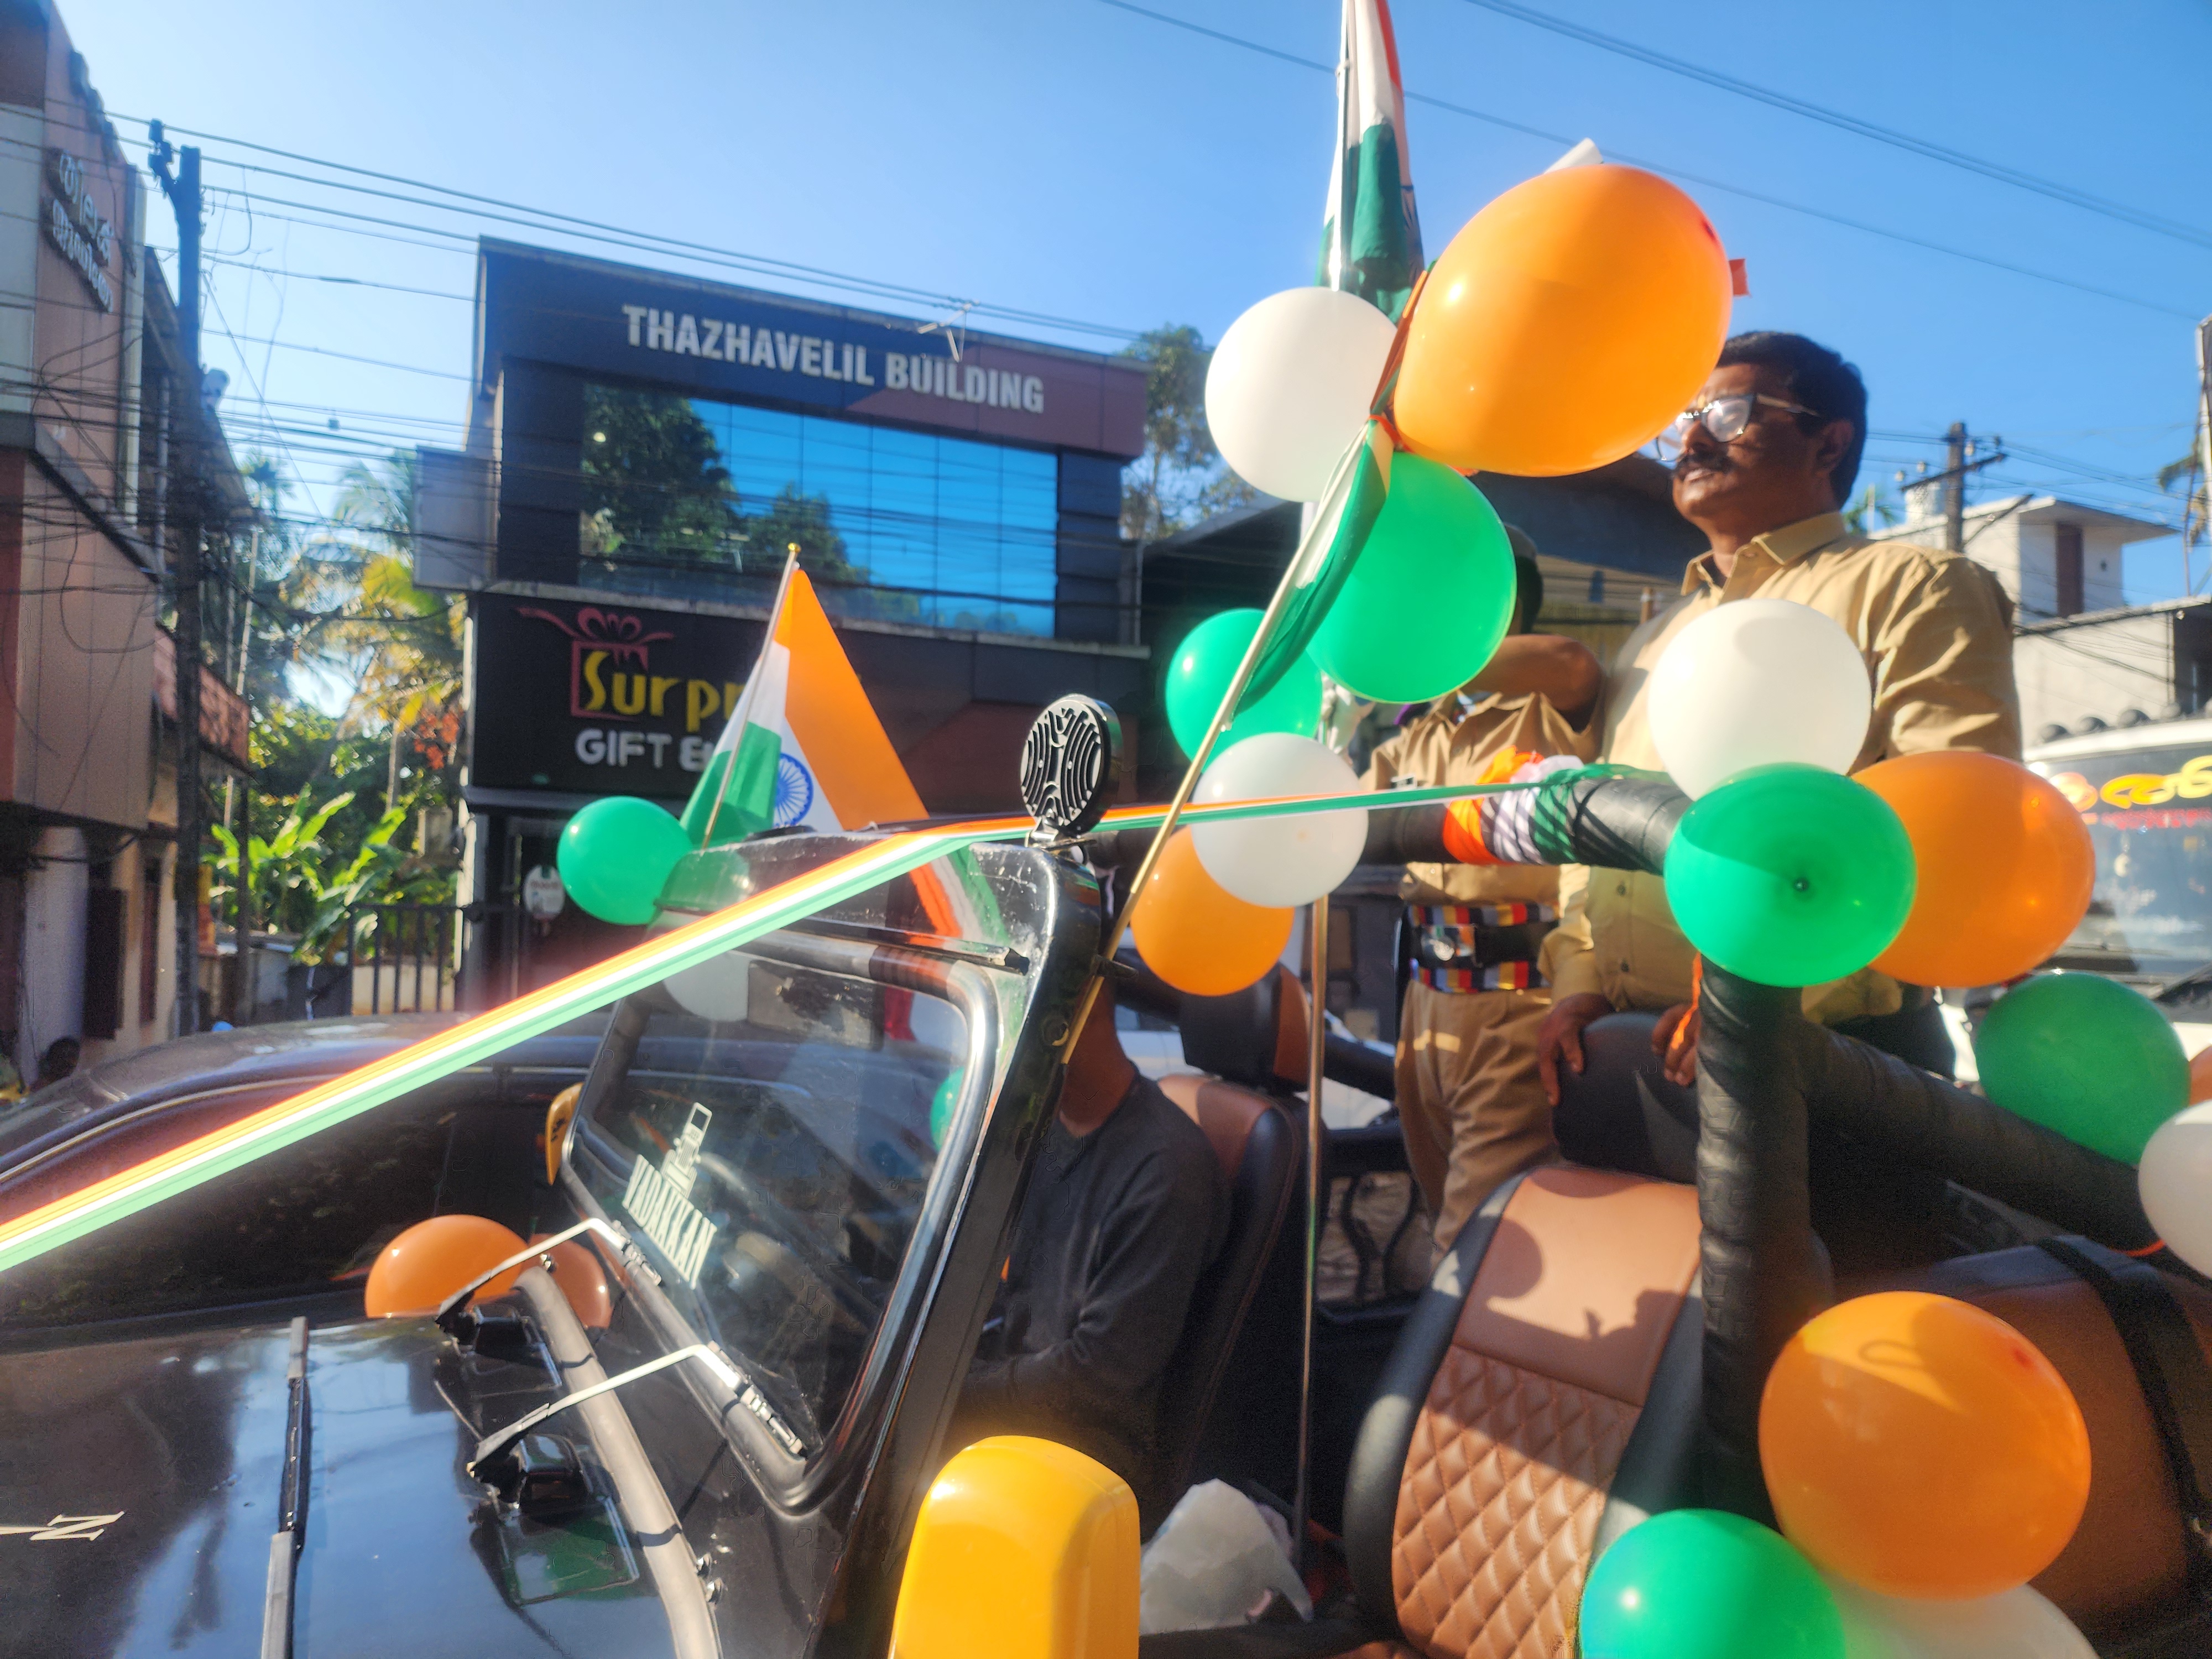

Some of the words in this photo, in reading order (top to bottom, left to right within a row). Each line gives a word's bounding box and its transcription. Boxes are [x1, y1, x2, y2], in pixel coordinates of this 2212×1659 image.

[622, 305, 874, 385] THAZHAVELIL
[886, 353, 1045, 413] BUILDING
[576, 728, 672, 768] GIFT
[623, 1154, 717, 1289] VADAKKAN
